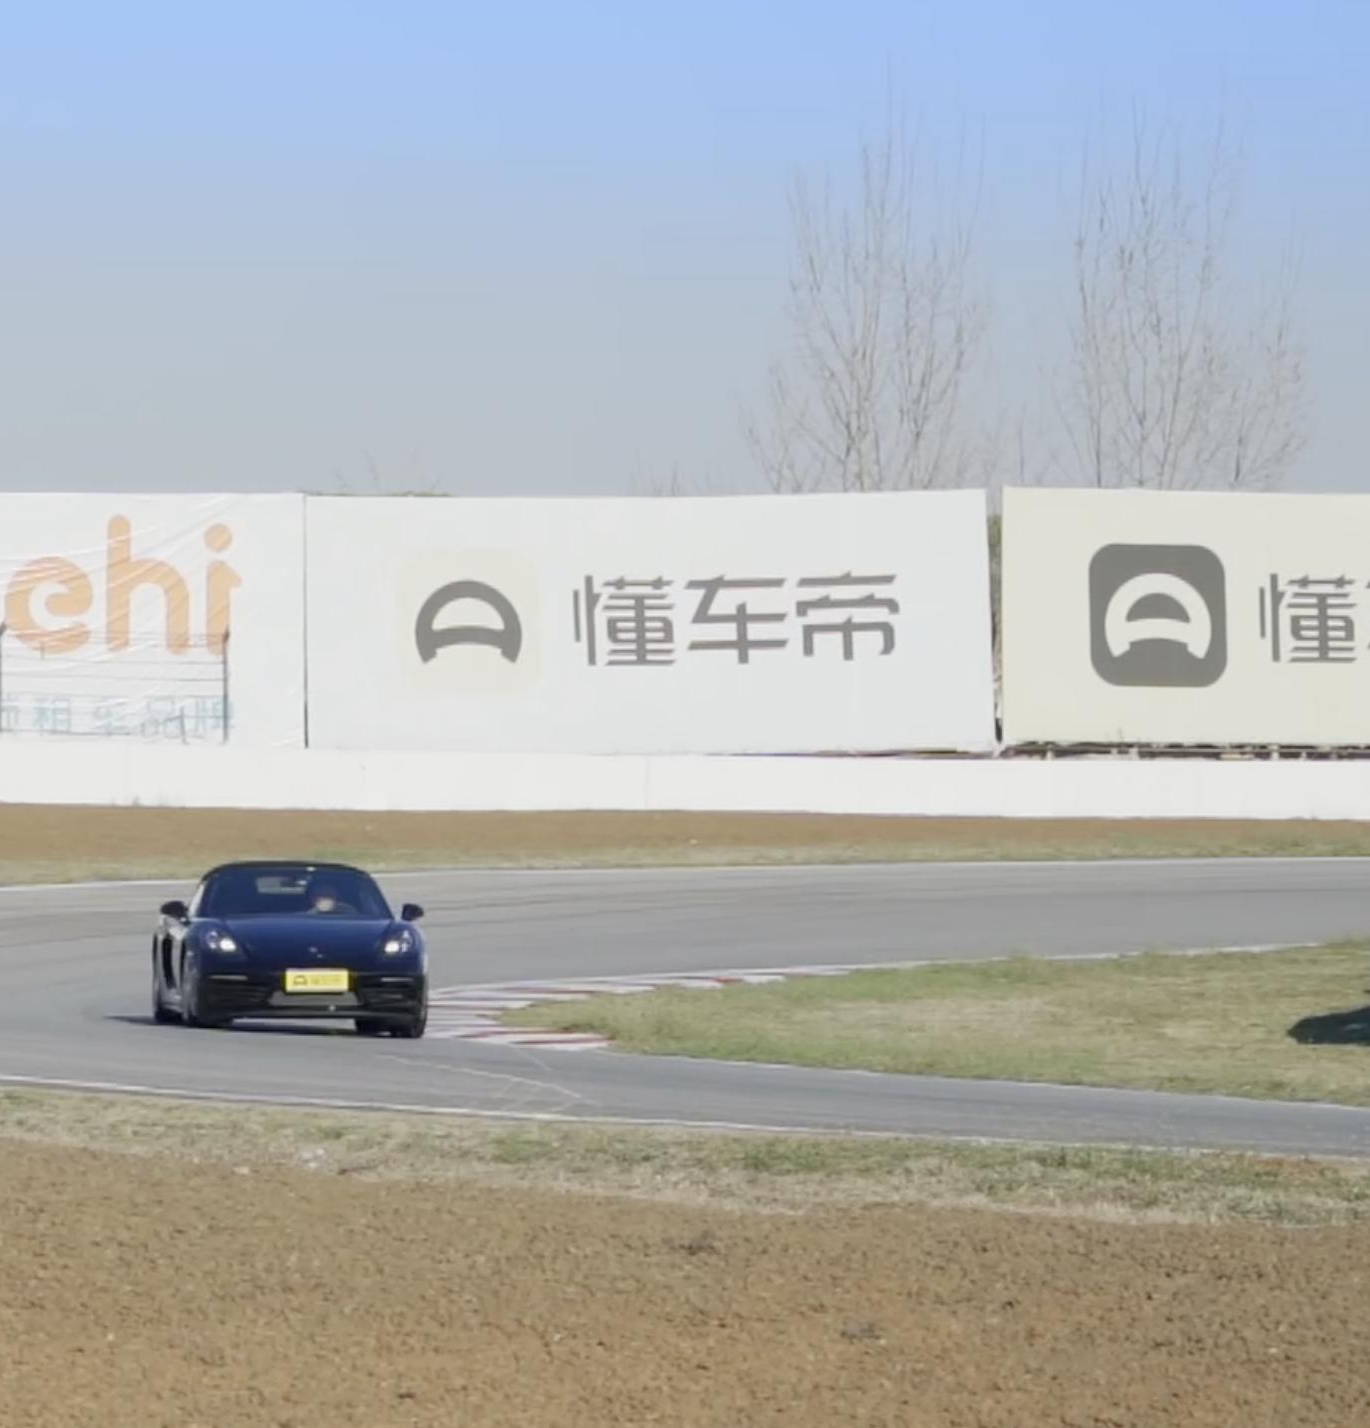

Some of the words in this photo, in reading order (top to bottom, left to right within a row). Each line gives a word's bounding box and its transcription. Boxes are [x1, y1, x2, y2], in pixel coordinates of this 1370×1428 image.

[573, 571, 900, 666] 懂车帝
[1259, 572, 1370, 663] 懂
